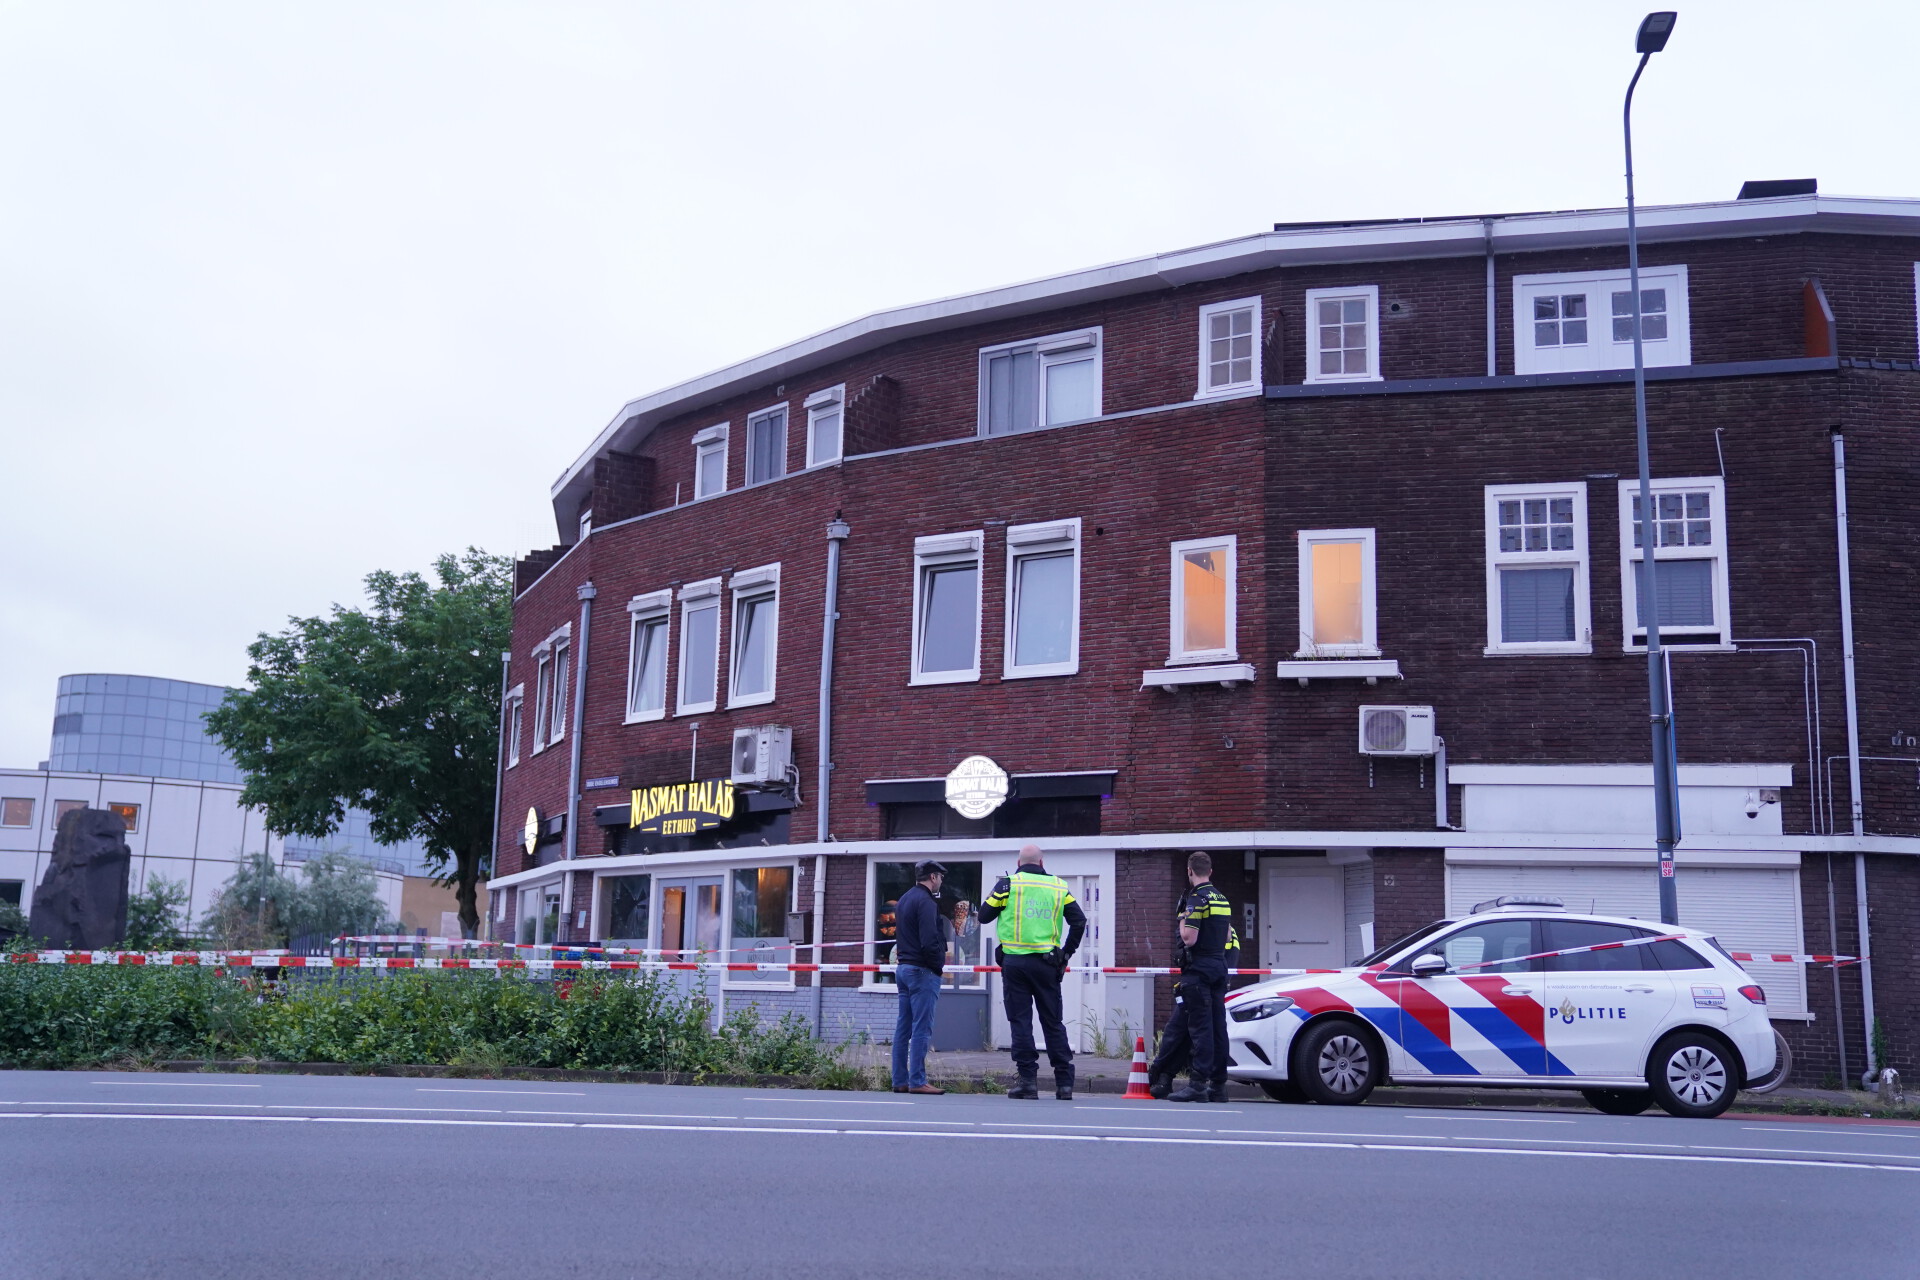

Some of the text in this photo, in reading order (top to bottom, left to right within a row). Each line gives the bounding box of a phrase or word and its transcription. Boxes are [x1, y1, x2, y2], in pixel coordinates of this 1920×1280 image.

[630, 779, 735, 829] NASMAT HALAB
[662, 818, 697, 835] EETHUIS
[1025, 907, 1052, 919] OVD
[1549, 1007, 1627, 1024] POLITIE
